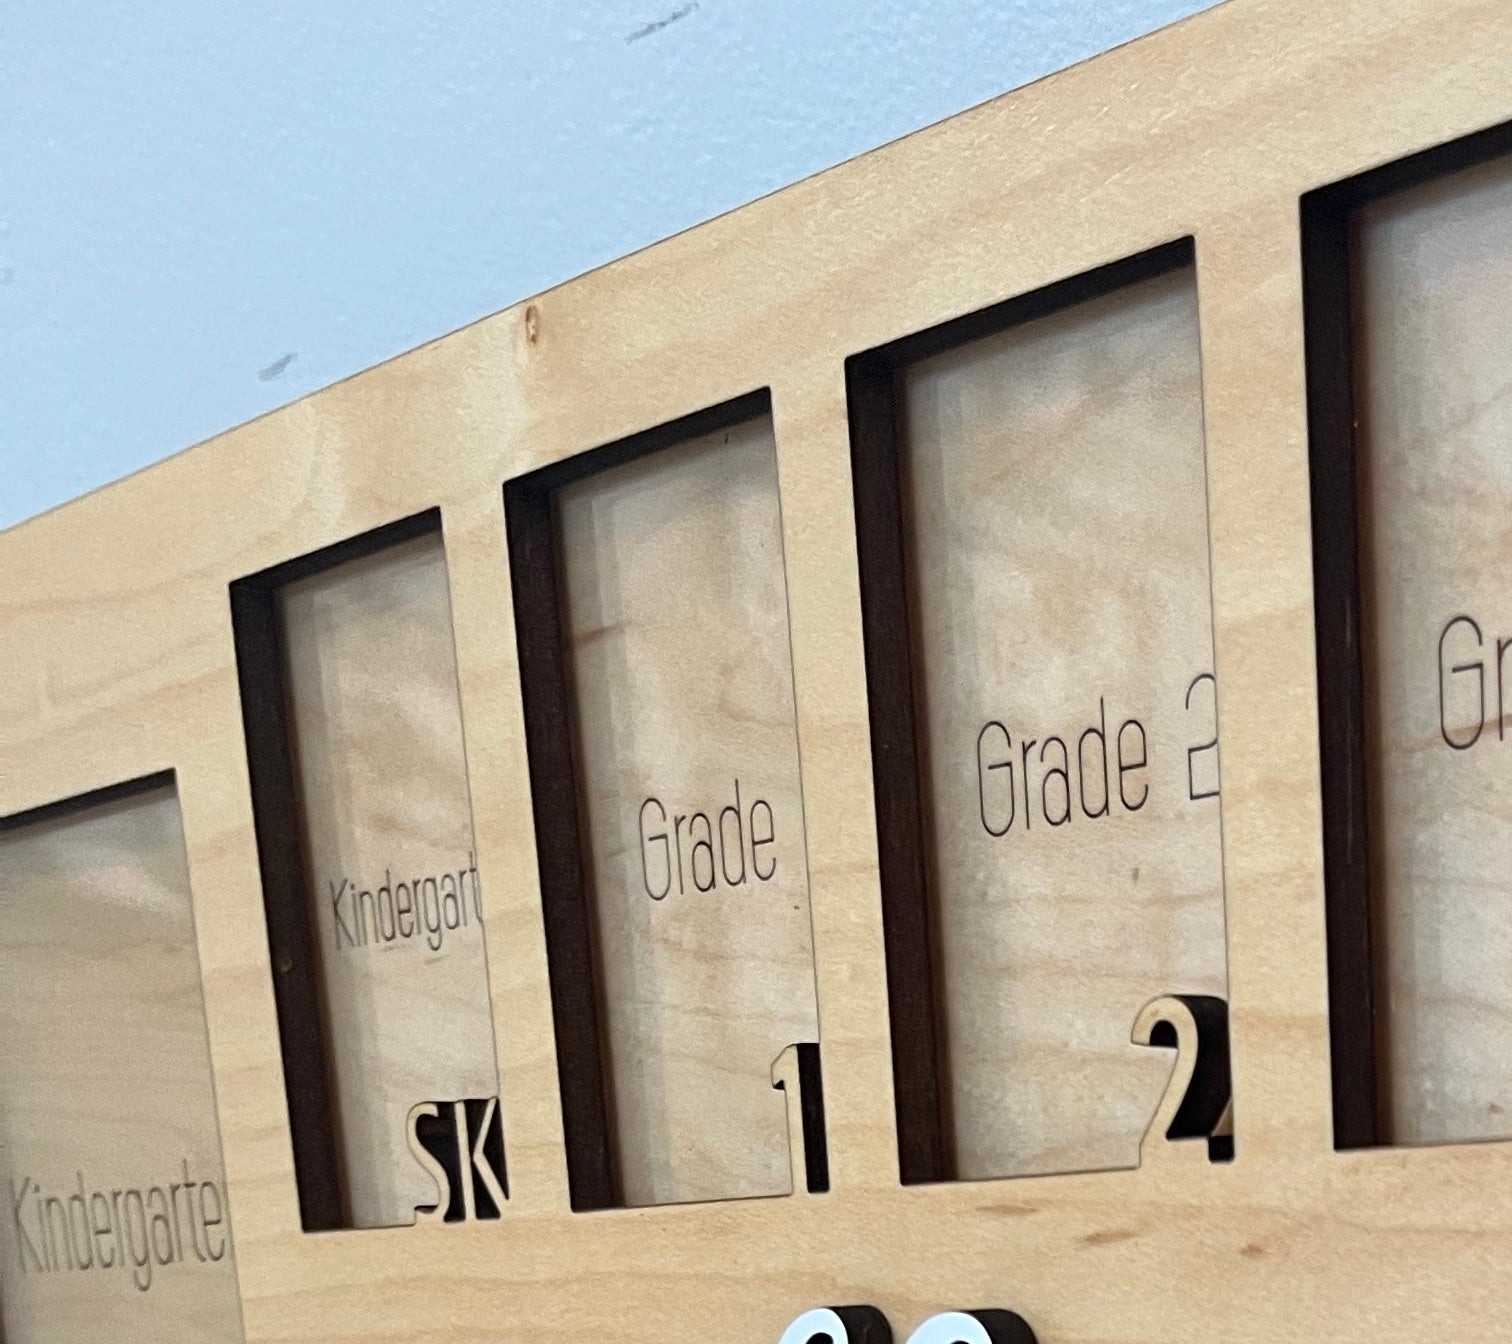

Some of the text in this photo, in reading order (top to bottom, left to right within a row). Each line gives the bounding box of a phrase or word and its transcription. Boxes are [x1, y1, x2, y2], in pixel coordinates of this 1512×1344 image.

[976, 674, 1220, 837] Grade 2
[639, 778, 777, 900] Grade
[771, 1042, 820, 1193] 1
[1131, 994, 1222, 1165] 2
[406, 1098, 508, 1222] SK
